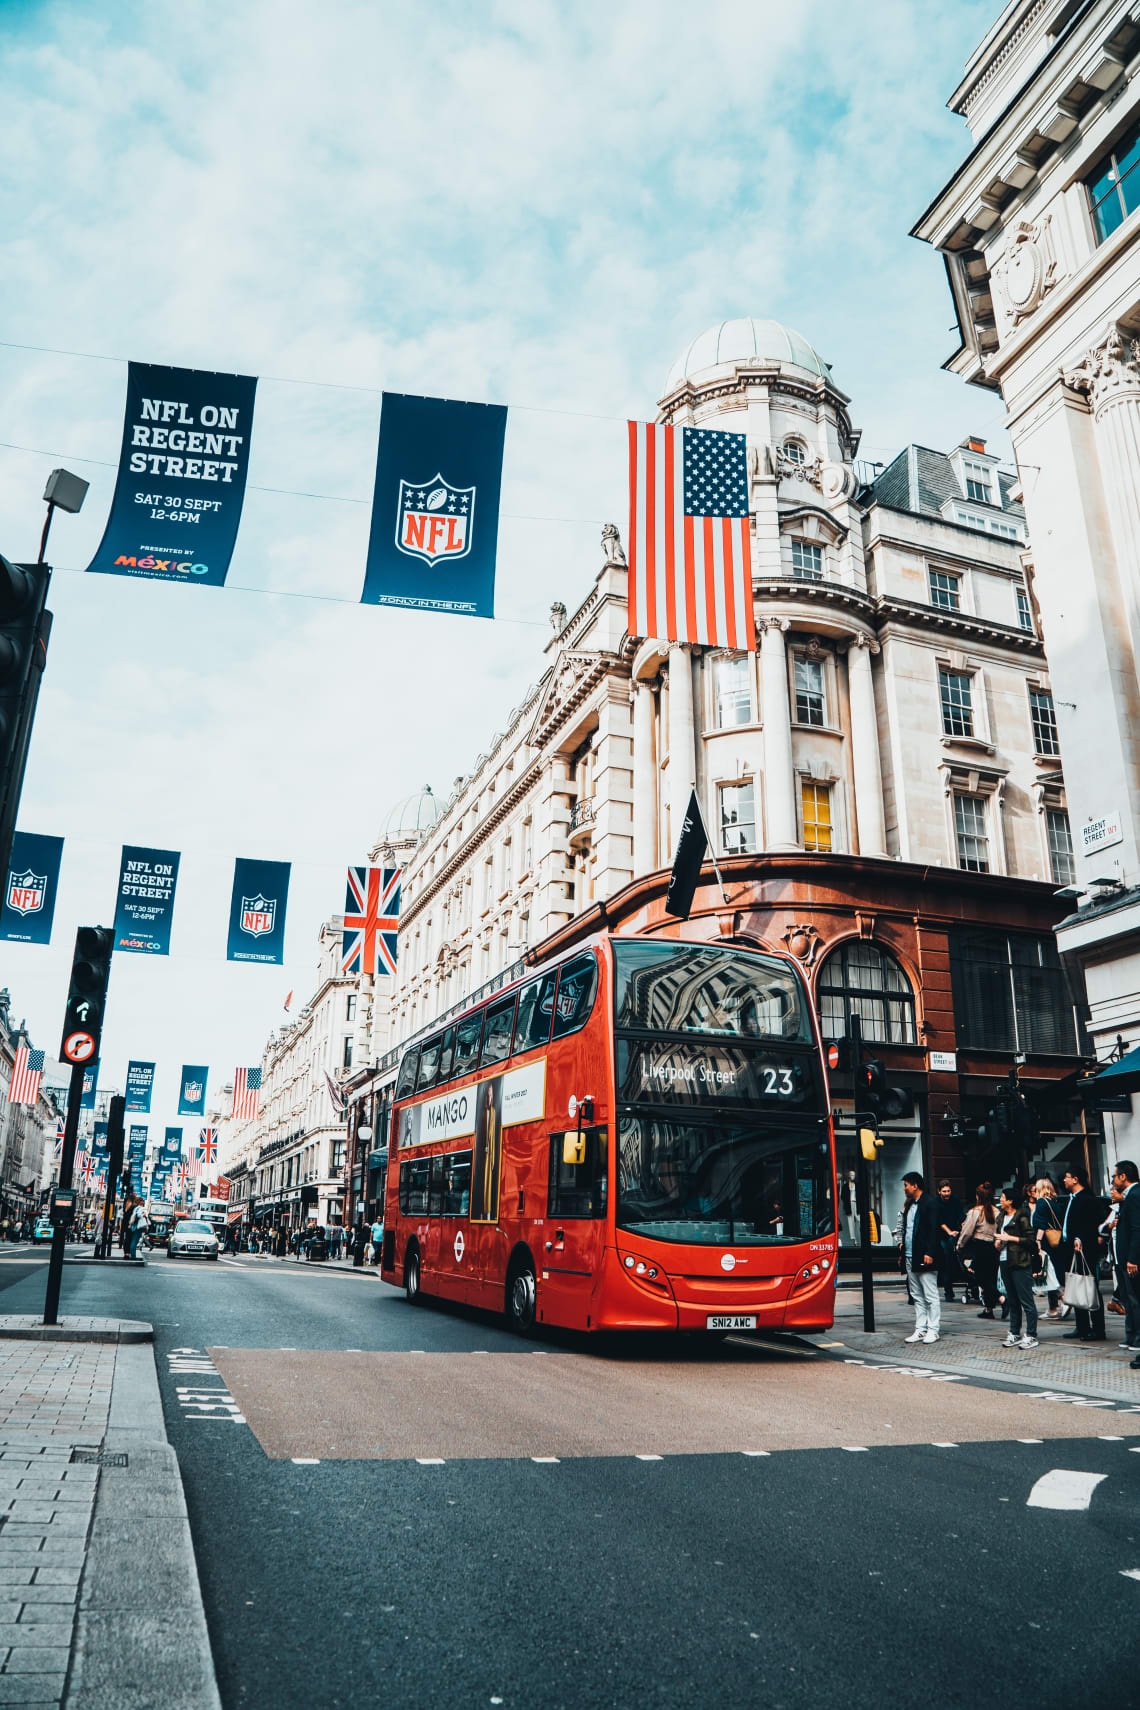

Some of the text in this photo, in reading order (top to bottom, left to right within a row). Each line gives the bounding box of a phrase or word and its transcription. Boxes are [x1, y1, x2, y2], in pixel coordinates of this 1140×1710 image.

[141, 398, 239, 429] NFL ON
[131, 425, 243, 456] REGENT
[129, 452, 238, 483] STREET
[134, 493, 222, 512] SAT 30 SEPT
[150, 508, 200, 524] 12-6PM
[404, 513, 463, 554] NFL
[140, 545, 183, 554] PRESENTED
[1083, 819, 1106, 836] REGENT
[1084, 829, 1106, 845] STREET
[127, 860, 173, 875] NFL ON
[122, 872, 175, 888] REGENT
[11, 888, 39, 909] NFL
[121, 884, 172, 900] STREET
[147, 906, 165, 914] SEPT
[244, 912, 270, 931] NFL
[642, 1059, 736, 1084] Liverpool Street
[763, 1068, 793, 1095] 23
[427, 1096, 468, 1129] MANGO
[712, 1317, 751, 1328] SN12 AWC
